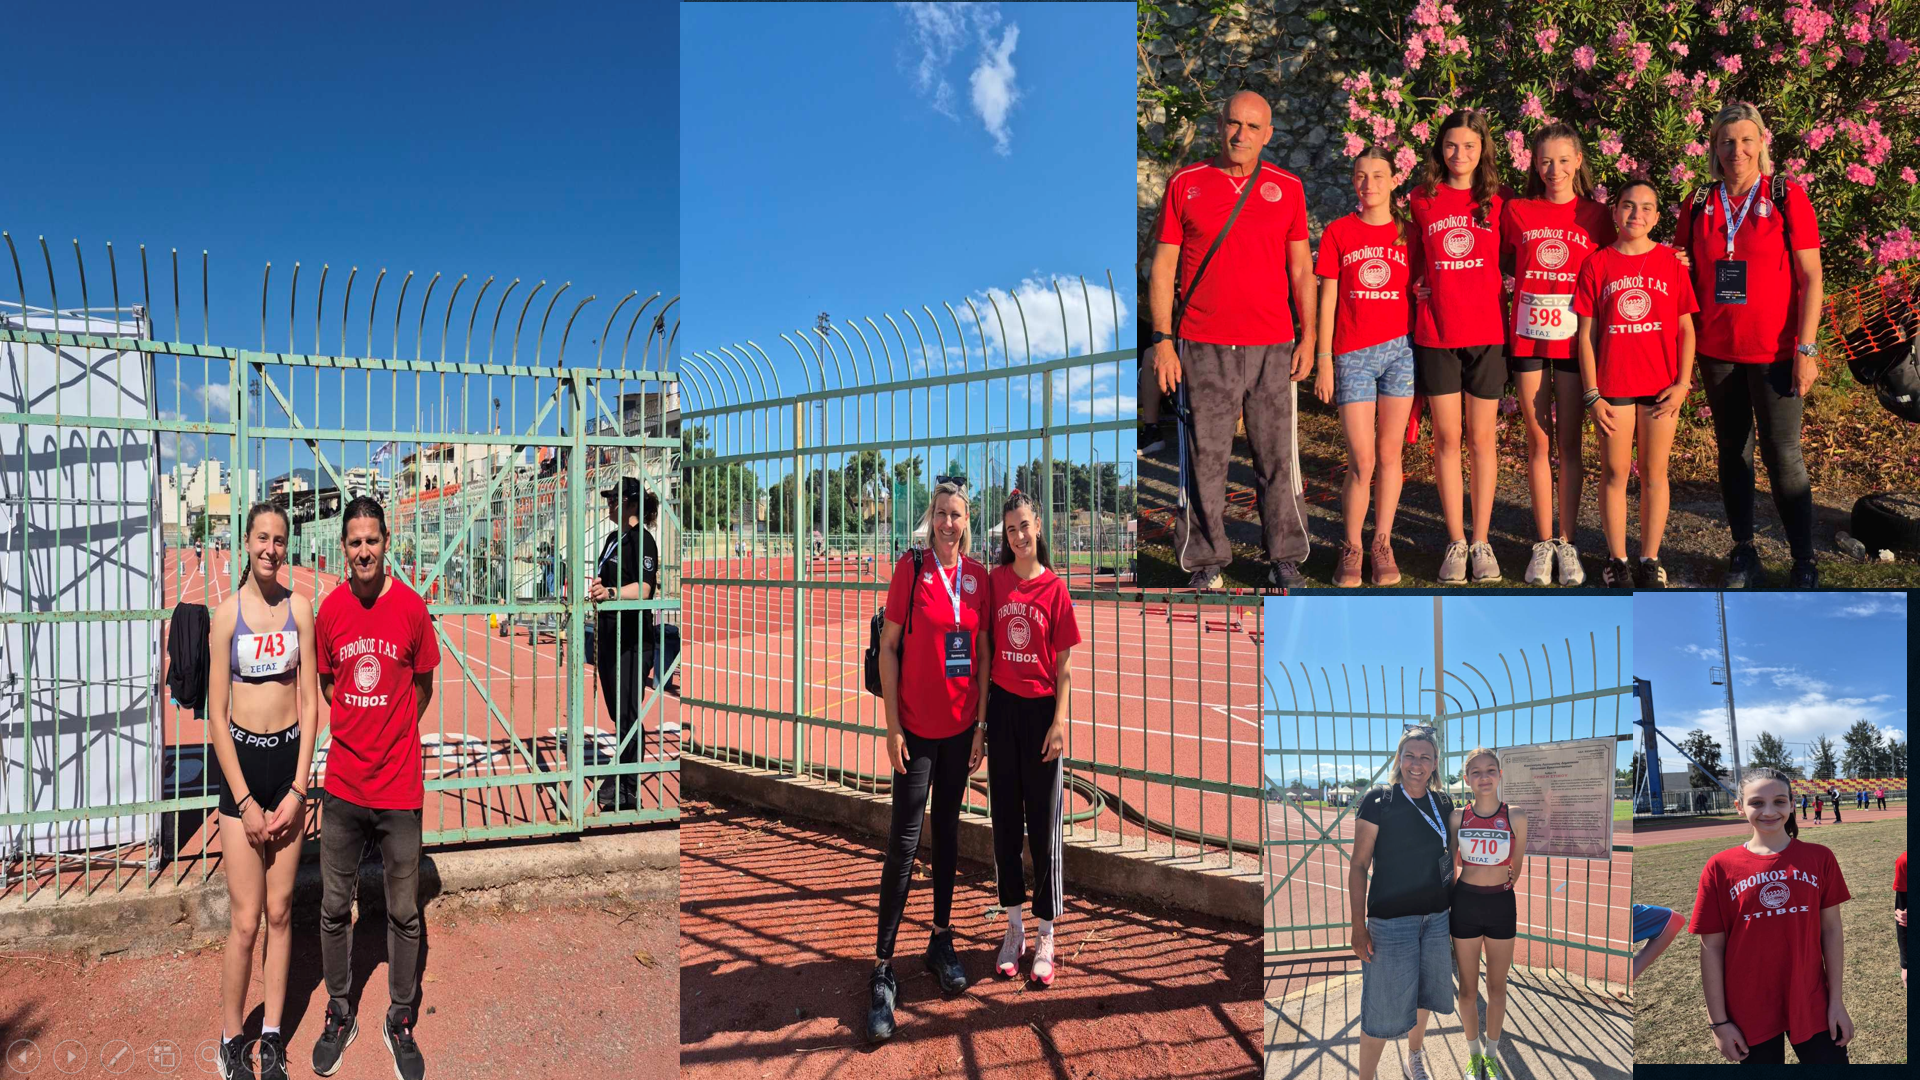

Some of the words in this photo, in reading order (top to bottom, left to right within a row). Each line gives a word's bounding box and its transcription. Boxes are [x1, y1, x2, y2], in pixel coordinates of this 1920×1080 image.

[1428, 214, 1468, 237] ΕΥΒΟΪΚΟΣ
[1522, 226, 1564, 244] ΕΥΒΟΪΚΟΣ
[1343, 244, 1384, 267] ΕΥΒΟΪΚΟΣ
[1435, 258, 1484, 270] ΣΤΙΒΟΣ
[1525, 270, 1576, 282] ΣΤΙΒΟΣ
[1350, 290, 1400, 300] ΣΤΙΒΟΣ
[1523, 296, 1569, 305] DACIA
[1529, 307, 1562, 327] 598
[1525, 328, 1551, 337] ΣΕΓΑΣ
[1608, 321, 1662, 334] ΣΤΙΒΟΣ
[254, 633, 285, 660] 743
[340, 636, 376, 662] ΕΥΒΟΪΚΟΣ
[1001, 650, 1038, 663] ΣΤΙΒΟΣ
[250, 662, 277, 673] ΣΕΓΑΣ
[344, 693, 388, 708] ΣΤΙΒΟΣ
[246, 735, 279, 748] PRO
[1470, 838, 1498, 855] 710
[1467, 855, 1489, 863] ΣΕΓΑΣ
[1729, 869, 1788, 902] ΕΥΒΟΪΚΟΣ
[1793, 869, 1820, 889] Γ.Α.Σ.
[1743, 905, 1809, 921] ΣΤΙΒΟΣ
